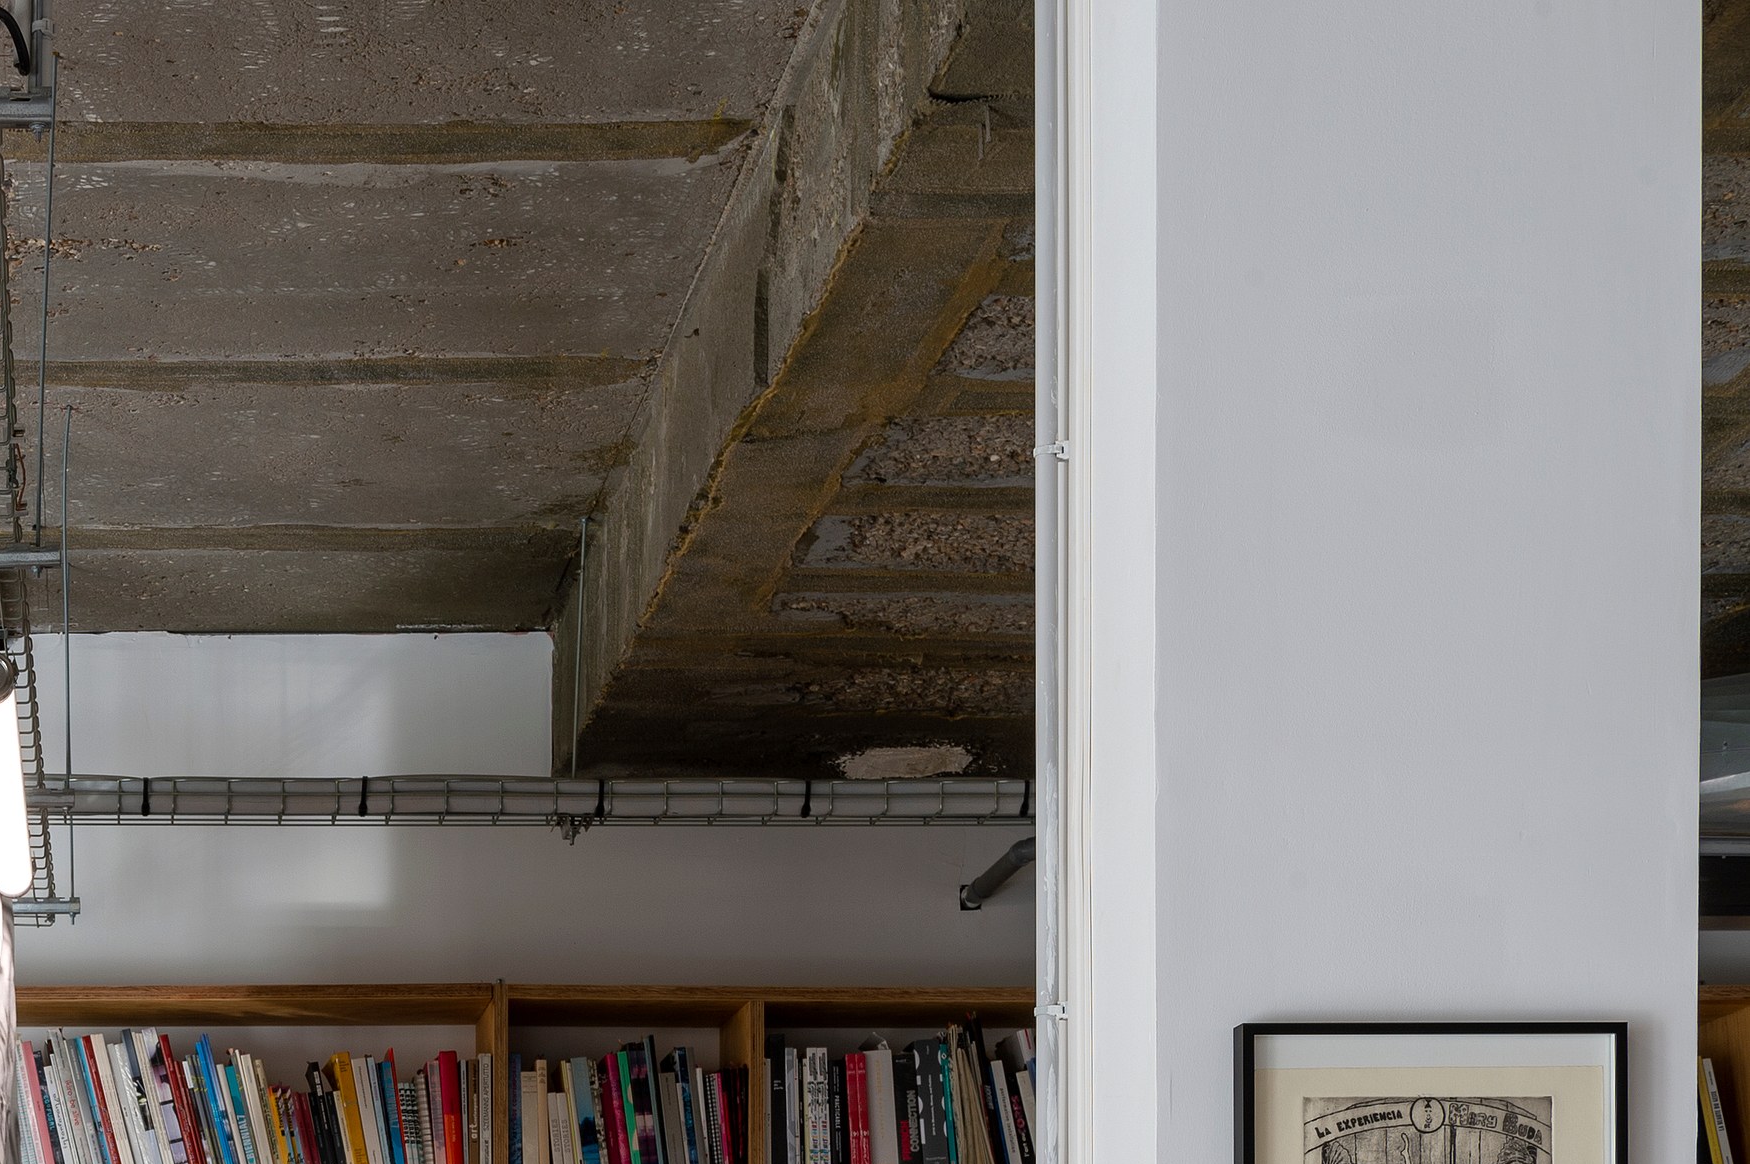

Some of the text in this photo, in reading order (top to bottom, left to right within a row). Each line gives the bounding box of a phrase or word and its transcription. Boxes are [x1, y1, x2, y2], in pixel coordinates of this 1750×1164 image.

[833, 1094, 841, 1128] PRACTICABLE
[906, 1089, 920, 1152] CONNECTION
[1335, 1107, 1404, 1135] EXPERIENCIA
[551, 1118, 561, 1152] STORIES
[561, 1118, 570, 1153] STORIES
